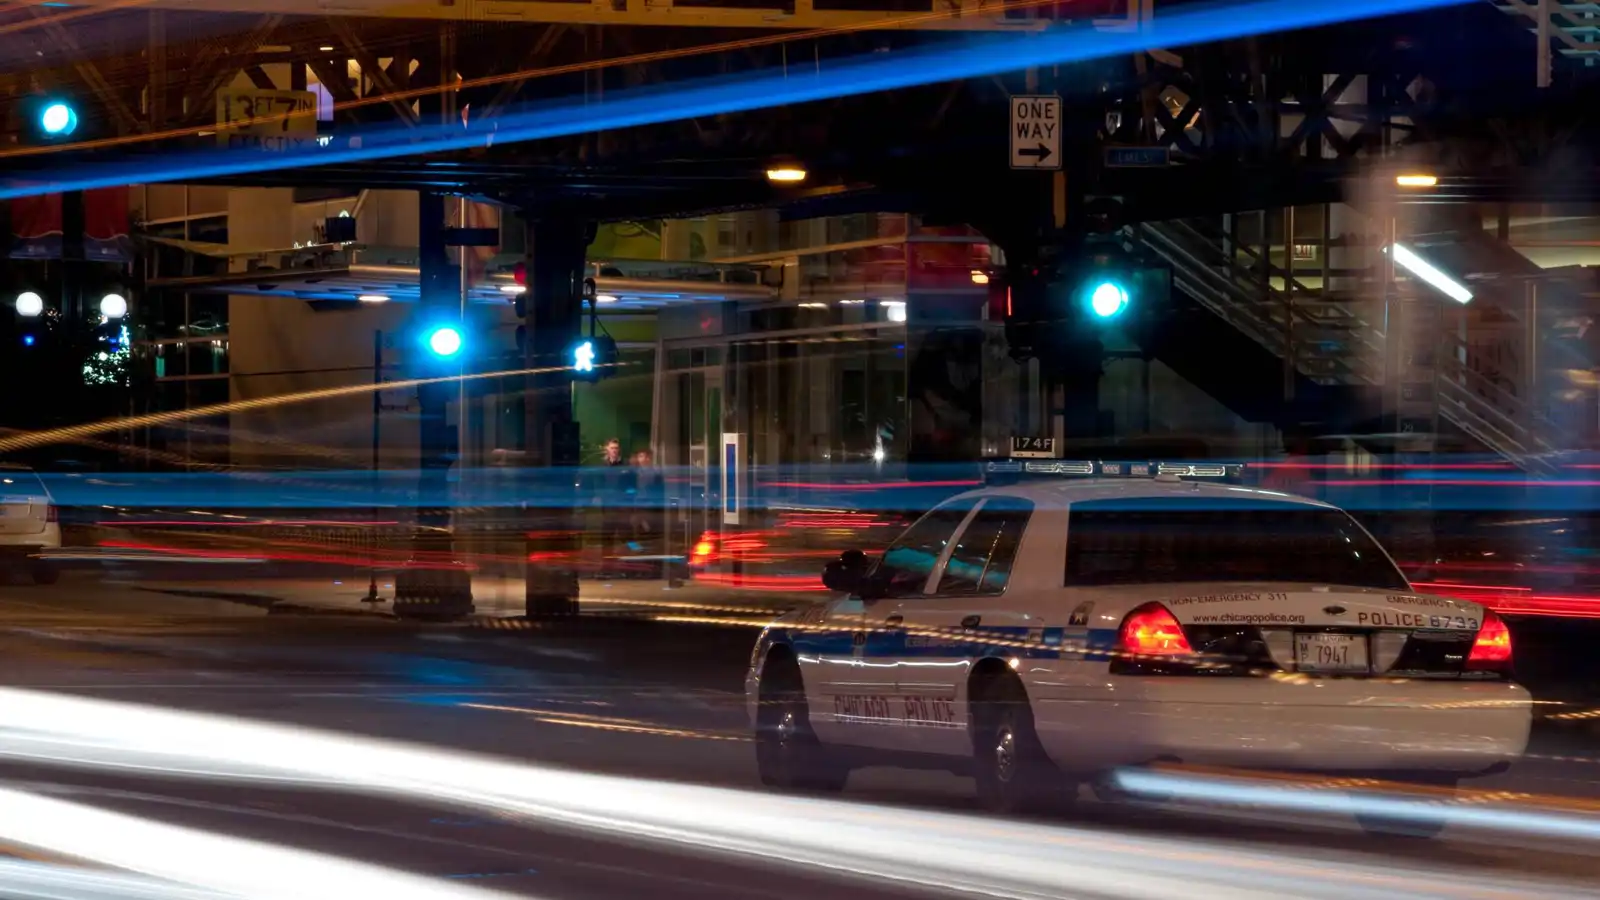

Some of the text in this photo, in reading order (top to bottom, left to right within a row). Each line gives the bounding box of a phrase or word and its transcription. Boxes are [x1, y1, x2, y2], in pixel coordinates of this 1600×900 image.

[224, 95, 313, 131] 13 FT 7 IN
[1017, 102, 1055, 119] ONE
[1017, 122, 1055, 139] WAY
[1016, 437, 1051, 449] 174F
[1169, 593, 1287, 606] NON-EMERGENCY 311
[1386, 595, 1453, 608] EMERGENCY
[1193, 613, 1305, 623] www.chicagopolice.org
[1358, 612, 1425, 627] POLICE
[1316, 646, 1348, 664] 7947
